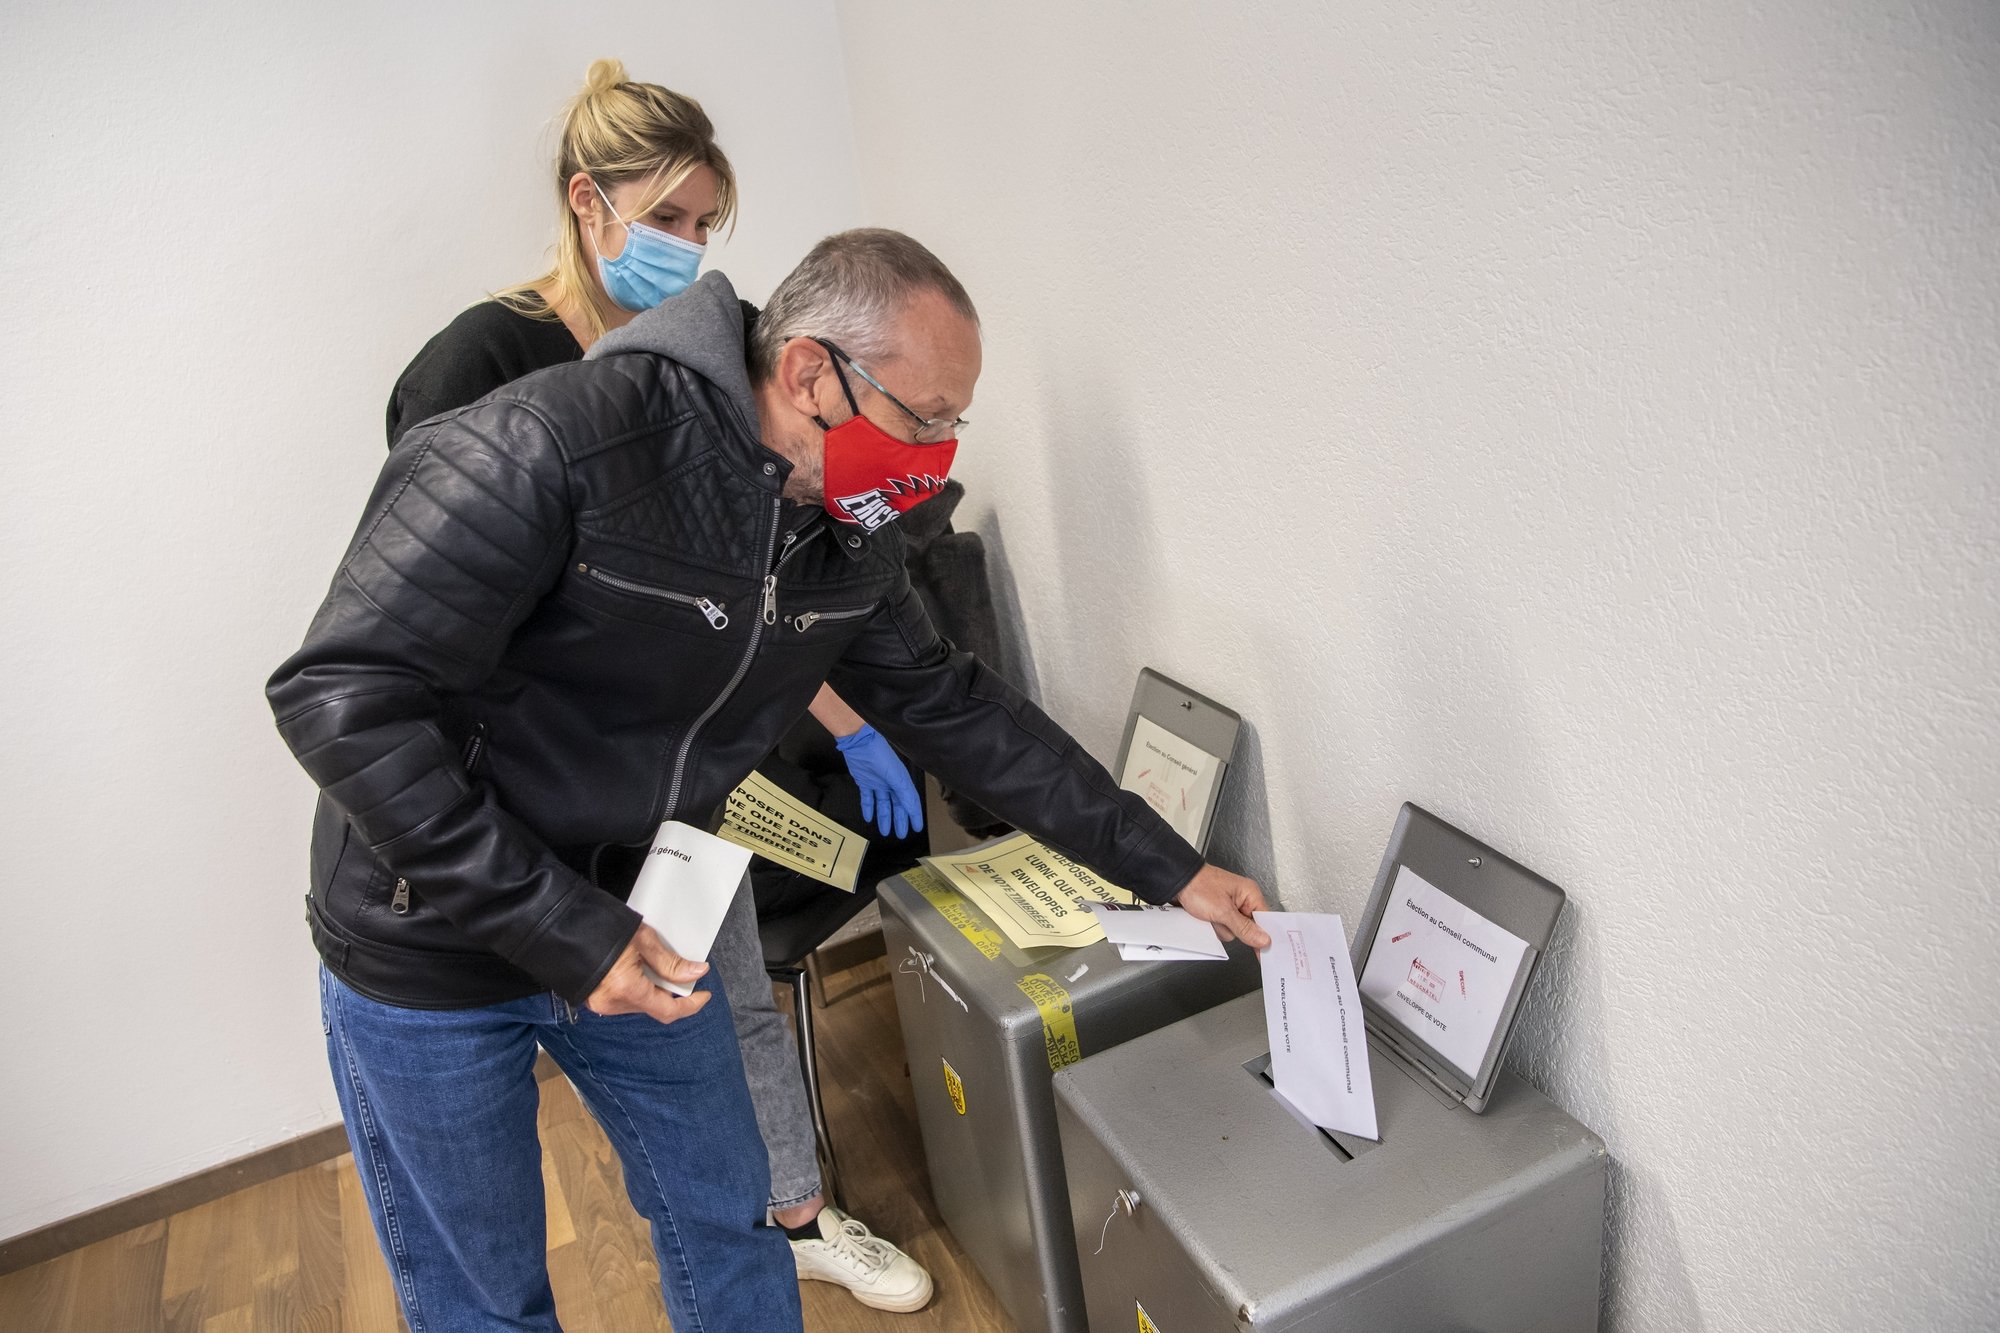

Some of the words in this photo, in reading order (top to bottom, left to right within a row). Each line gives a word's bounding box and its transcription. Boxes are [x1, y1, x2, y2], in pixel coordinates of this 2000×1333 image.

[1167, 754, 1182, 766] Conseil
[733, 822, 816, 864] TIMBRÉES
[751, 810, 783, 830] QUE
[787, 830, 818, 848] DES
[789, 819, 833, 845] DANS
[657, 846, 692, 862] général
[1011, 868, 1068, 918] ENVELOPPES
[1025, 854, 1058, 880] L'URNE
[1054, 878, 1077, 898] QUE
[1092, 886, 1118, 903] DAN
[978, 863, 995, 876] DE
[991, 873, 1016, 896] VOTE
[1008, 891, 1055, 929] TIMBRÉES
[938, 905, 966, 930] ABIERTO
[1406, 897, 1429, 919] Élection
[1429, 916, 1438, 925] au
[1438, 921, 1462, 941] Conseil
[1462, 936, 1498, 964] communal
[1329, 956, 1341, 993] Élection
[1334, 994, 1342, 1006] au
[1396, 990, 1425, 1015] ENVELOPPE
[1425, 1011, 1432, 1021] DE
[1432, 1016, 1447, 1031] VOTE
[1284, 1022, 1288, 1032] DE
[1340, 1008, 1348, 1043] Conseil
[1343, 1045, 1353, 1094] communal
